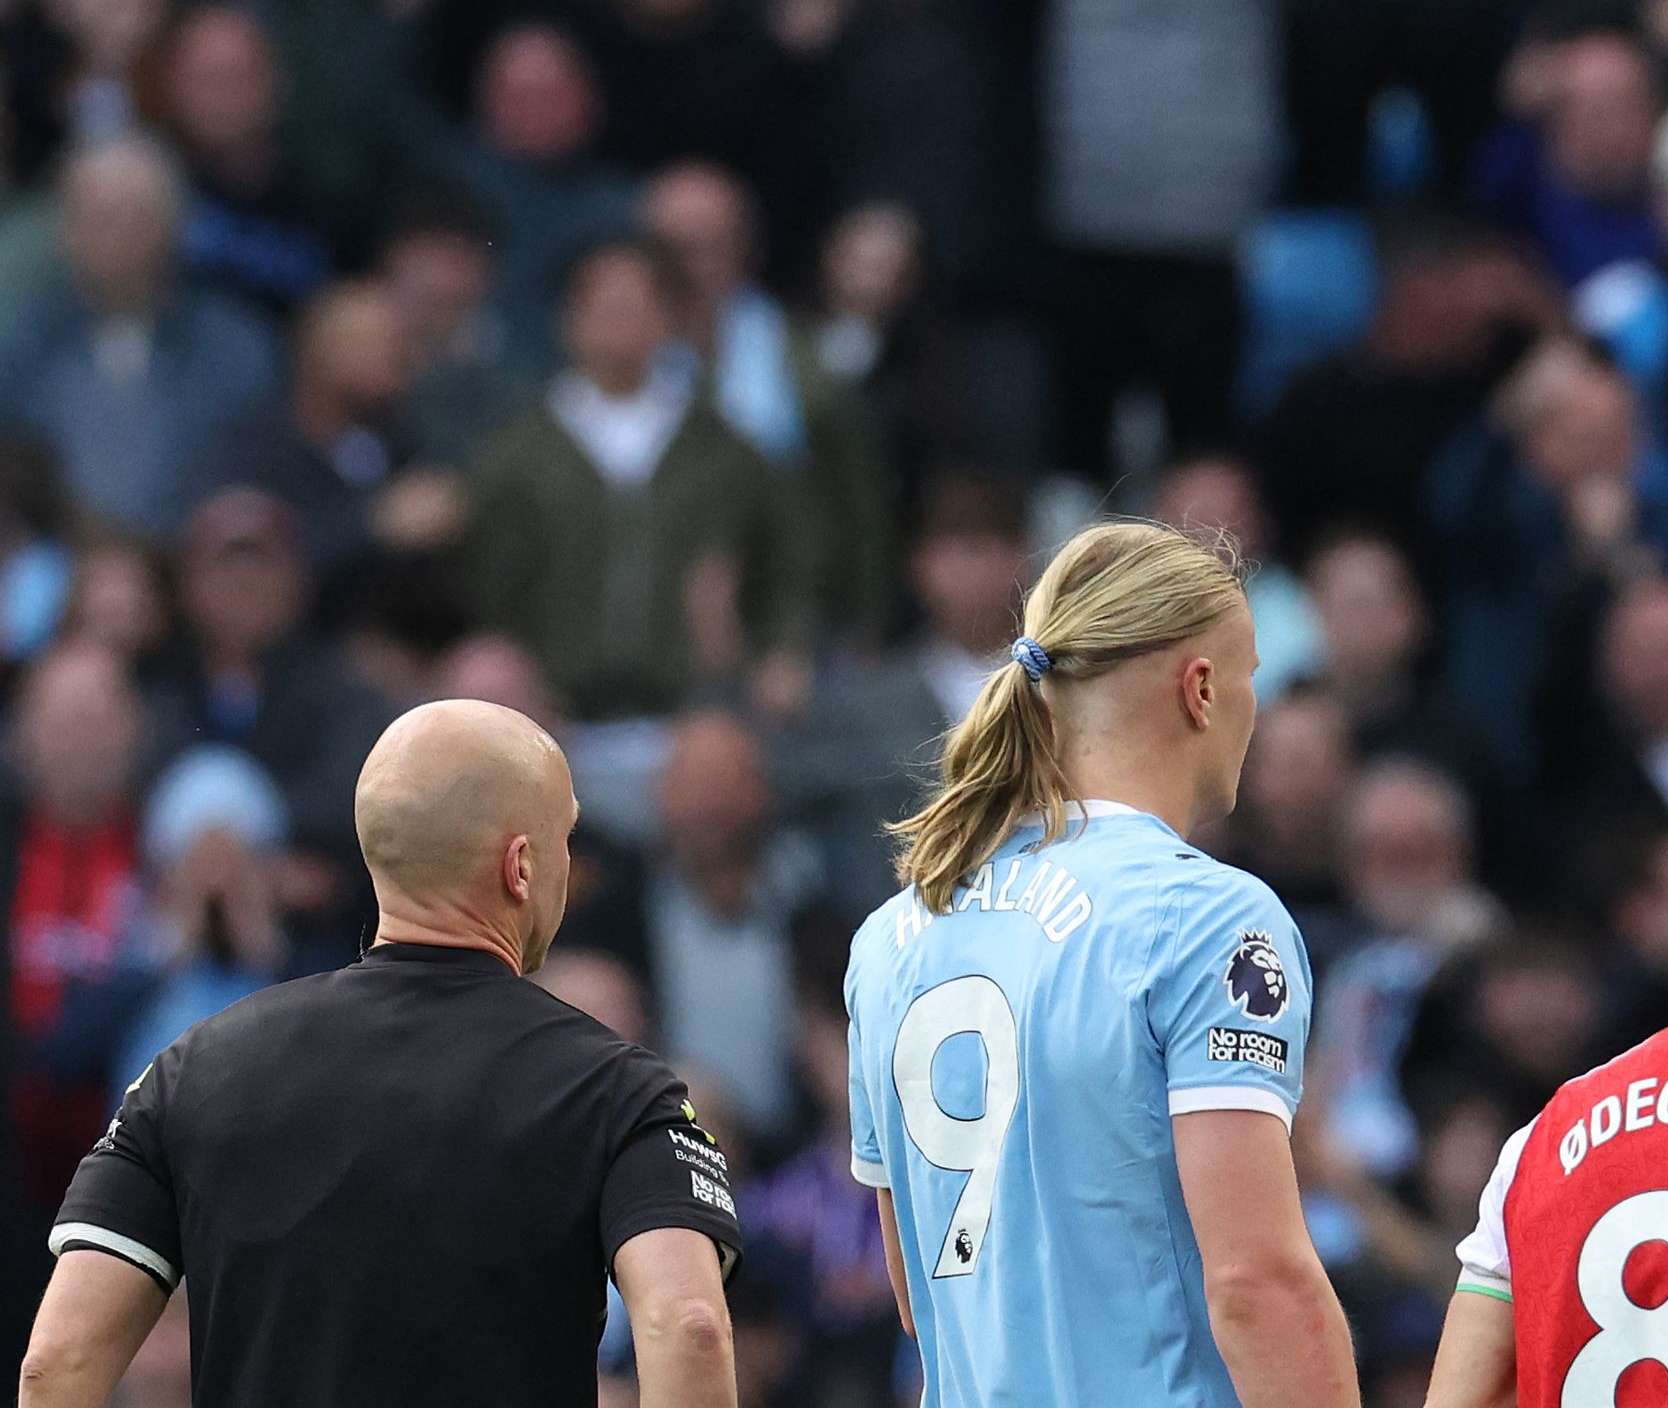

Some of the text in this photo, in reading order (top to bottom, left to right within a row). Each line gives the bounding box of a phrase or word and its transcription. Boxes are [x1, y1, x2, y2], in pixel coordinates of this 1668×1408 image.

[1208, 1043, 1285, 1073] for racism
[1209, 1028, 1282, 1057] No room
[892, 974, 1020, 1279] 9
[667, 1128, 728, 1172] HuwsG
